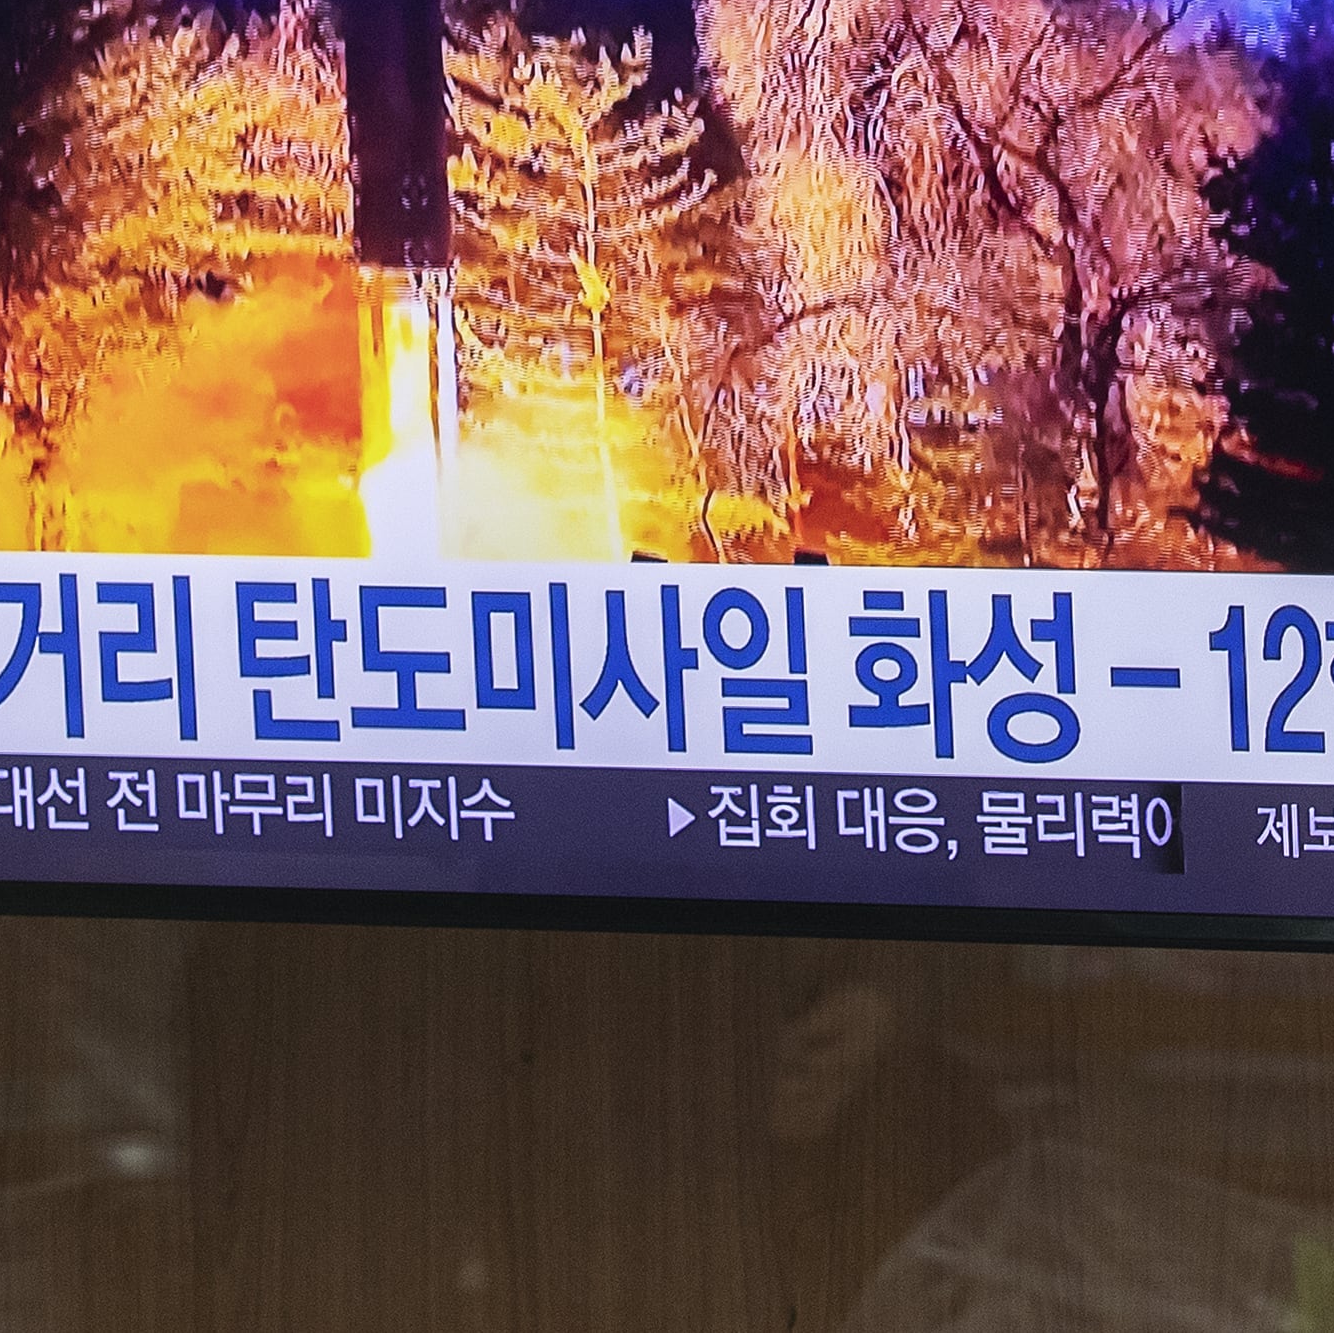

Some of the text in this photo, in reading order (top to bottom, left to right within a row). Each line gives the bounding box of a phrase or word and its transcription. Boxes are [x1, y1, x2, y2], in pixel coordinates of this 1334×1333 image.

[234, 577, 814, 756] 탄도미사일
[106, 770, 160, 833] 전
[177, 771, 334, 838] 마무리
[355, 774, 516, 843] 미지수
[708, 785, 817, 850] 집회
[837, 788, 959, 861] 대응,
